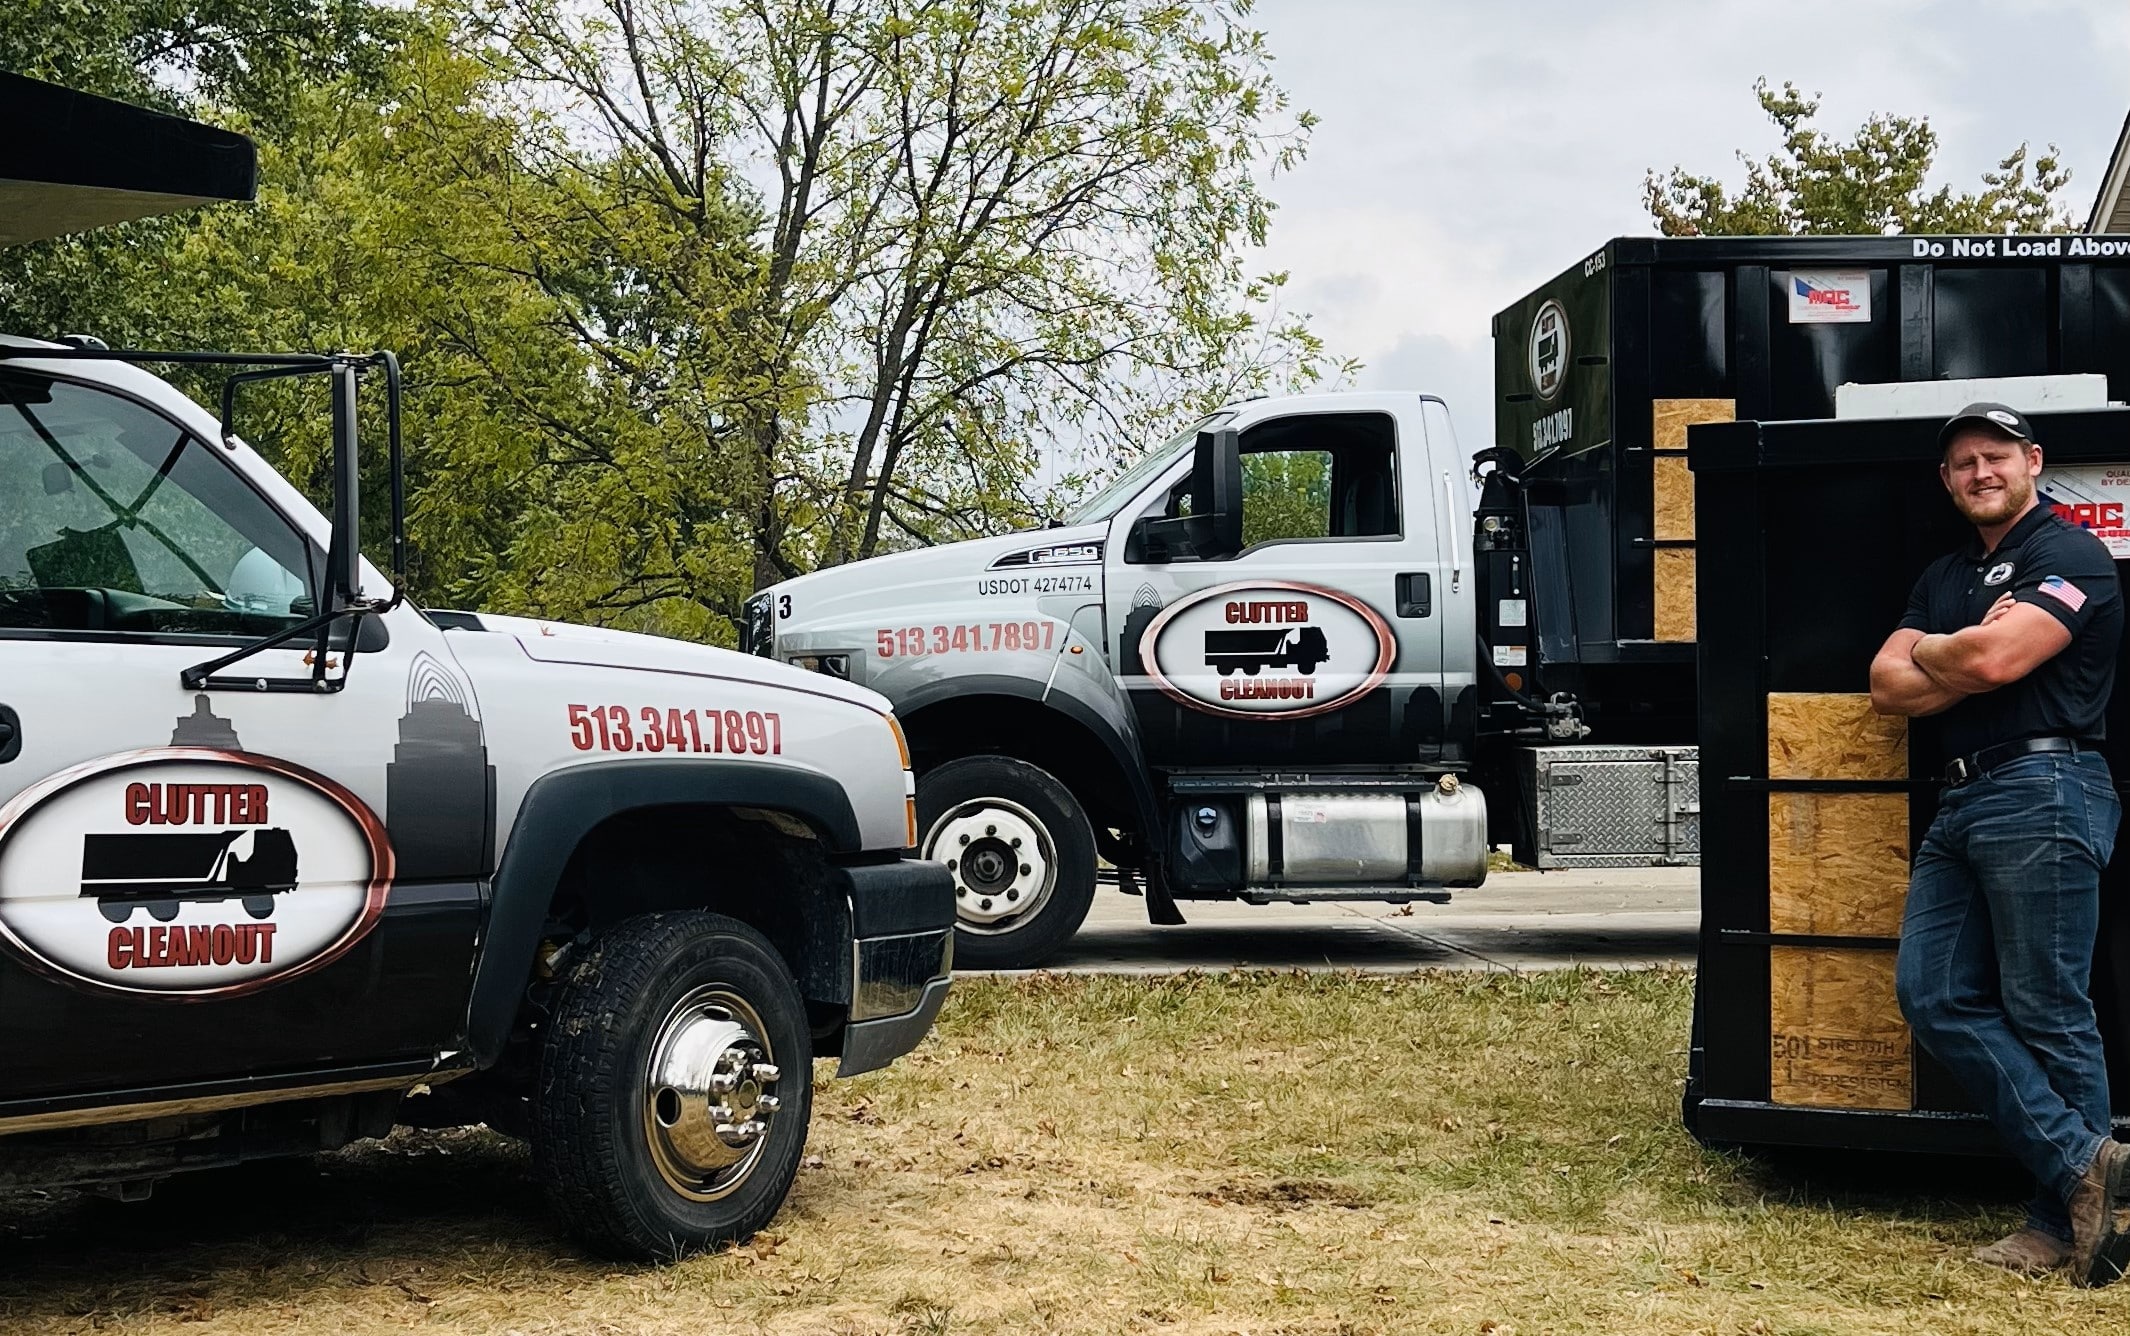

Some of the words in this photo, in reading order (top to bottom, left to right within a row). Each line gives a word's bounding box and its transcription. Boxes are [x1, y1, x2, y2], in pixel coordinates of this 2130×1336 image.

[1913, 239, 1945, 257] Do
[1952, 239, 1996, 257] Not
[2002, 238, 2061, 256] Load
[2067, 237, 2130, 256] Abov
[978, 579, 1030, 596] USDOT
[1033, 576, 1093, 593] 4274774
[779, 595, 792, 619] 3
[1225, 601, 1309, 624] CLUTTER
[877, 621, 1054, 657] 513.341.7897
[1220, 678, 1315, 700] CLEANOUT
[568, 703, 781, 755] 513.341.7897
[125, 782, 269, 826] CLUTTER
[107, 923, 277, 970] CLEANOUT
